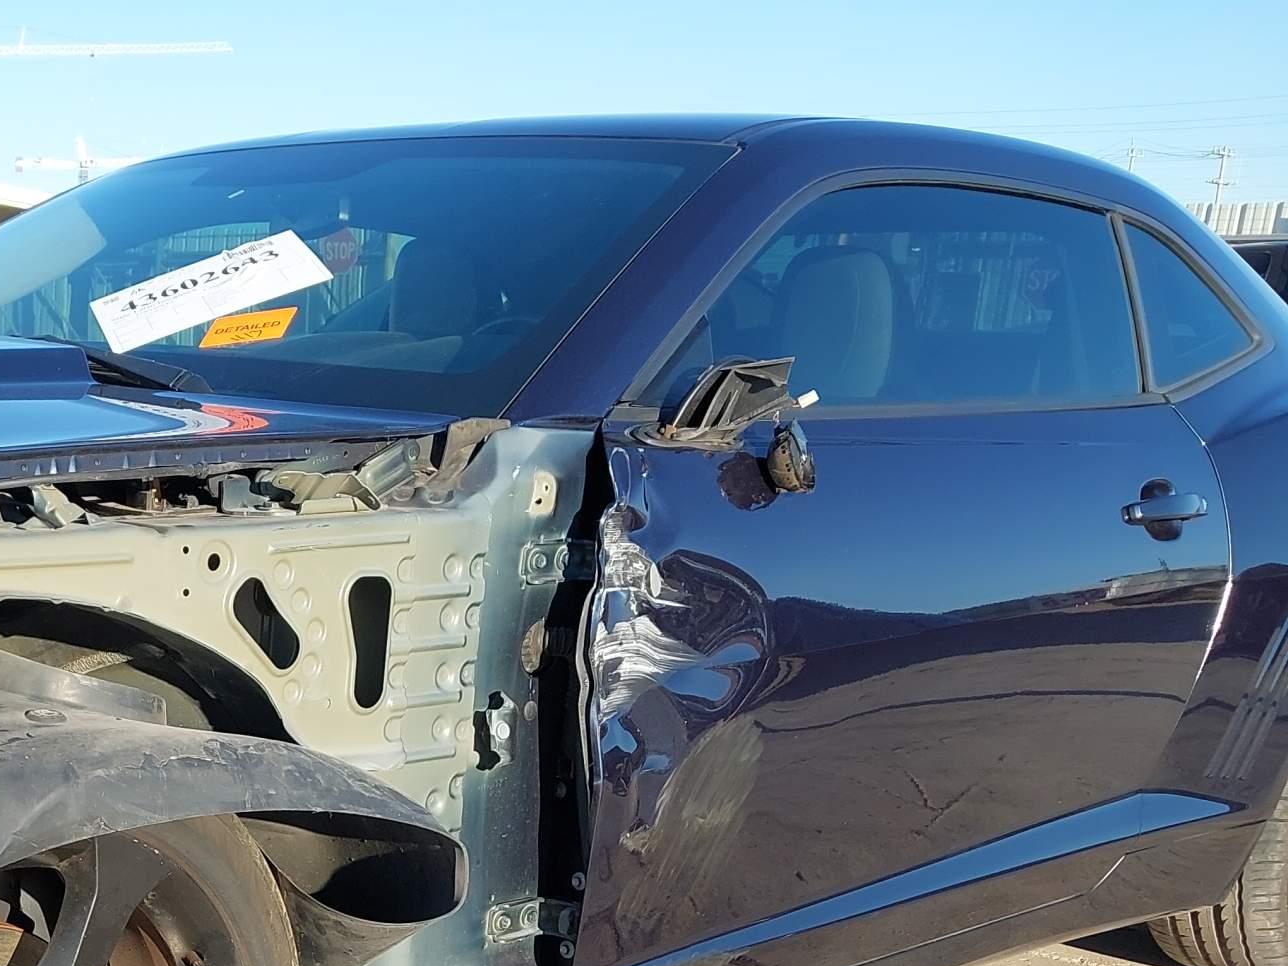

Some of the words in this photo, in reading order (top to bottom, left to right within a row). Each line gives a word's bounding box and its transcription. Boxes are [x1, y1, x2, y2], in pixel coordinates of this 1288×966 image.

[325, 240, 356, 261] STOP
[119, 249, 280, 312] 43602643
[214, 320, 281, 335] DETAILED
